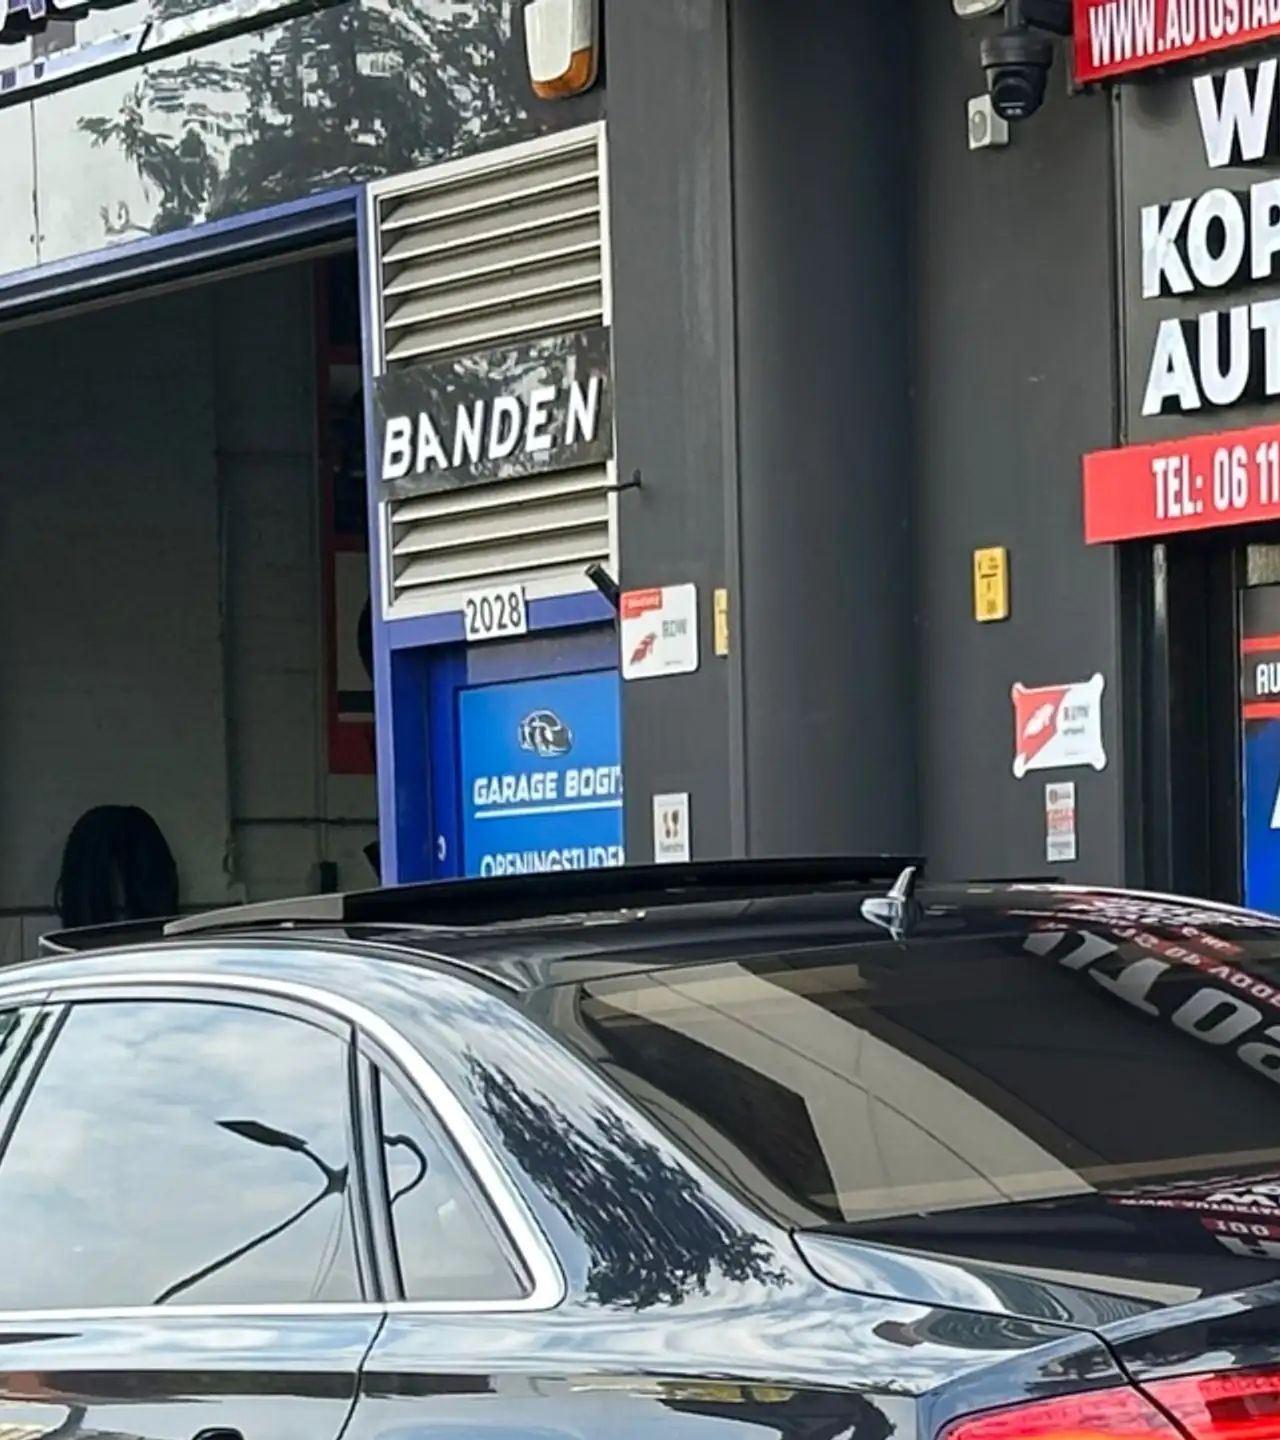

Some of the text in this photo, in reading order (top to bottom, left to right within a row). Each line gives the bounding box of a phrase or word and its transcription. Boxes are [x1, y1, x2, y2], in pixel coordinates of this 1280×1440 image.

[381, 375, 599, 481] BANDEN
[1151, 453, 1204, 520] TEL:
[1213, 445, 1249, 511] 06
[1255, 440, 1280, 504] 11
[466, 591, 522, 635] 2028
[474, 773, 558, 806] GARAGE
